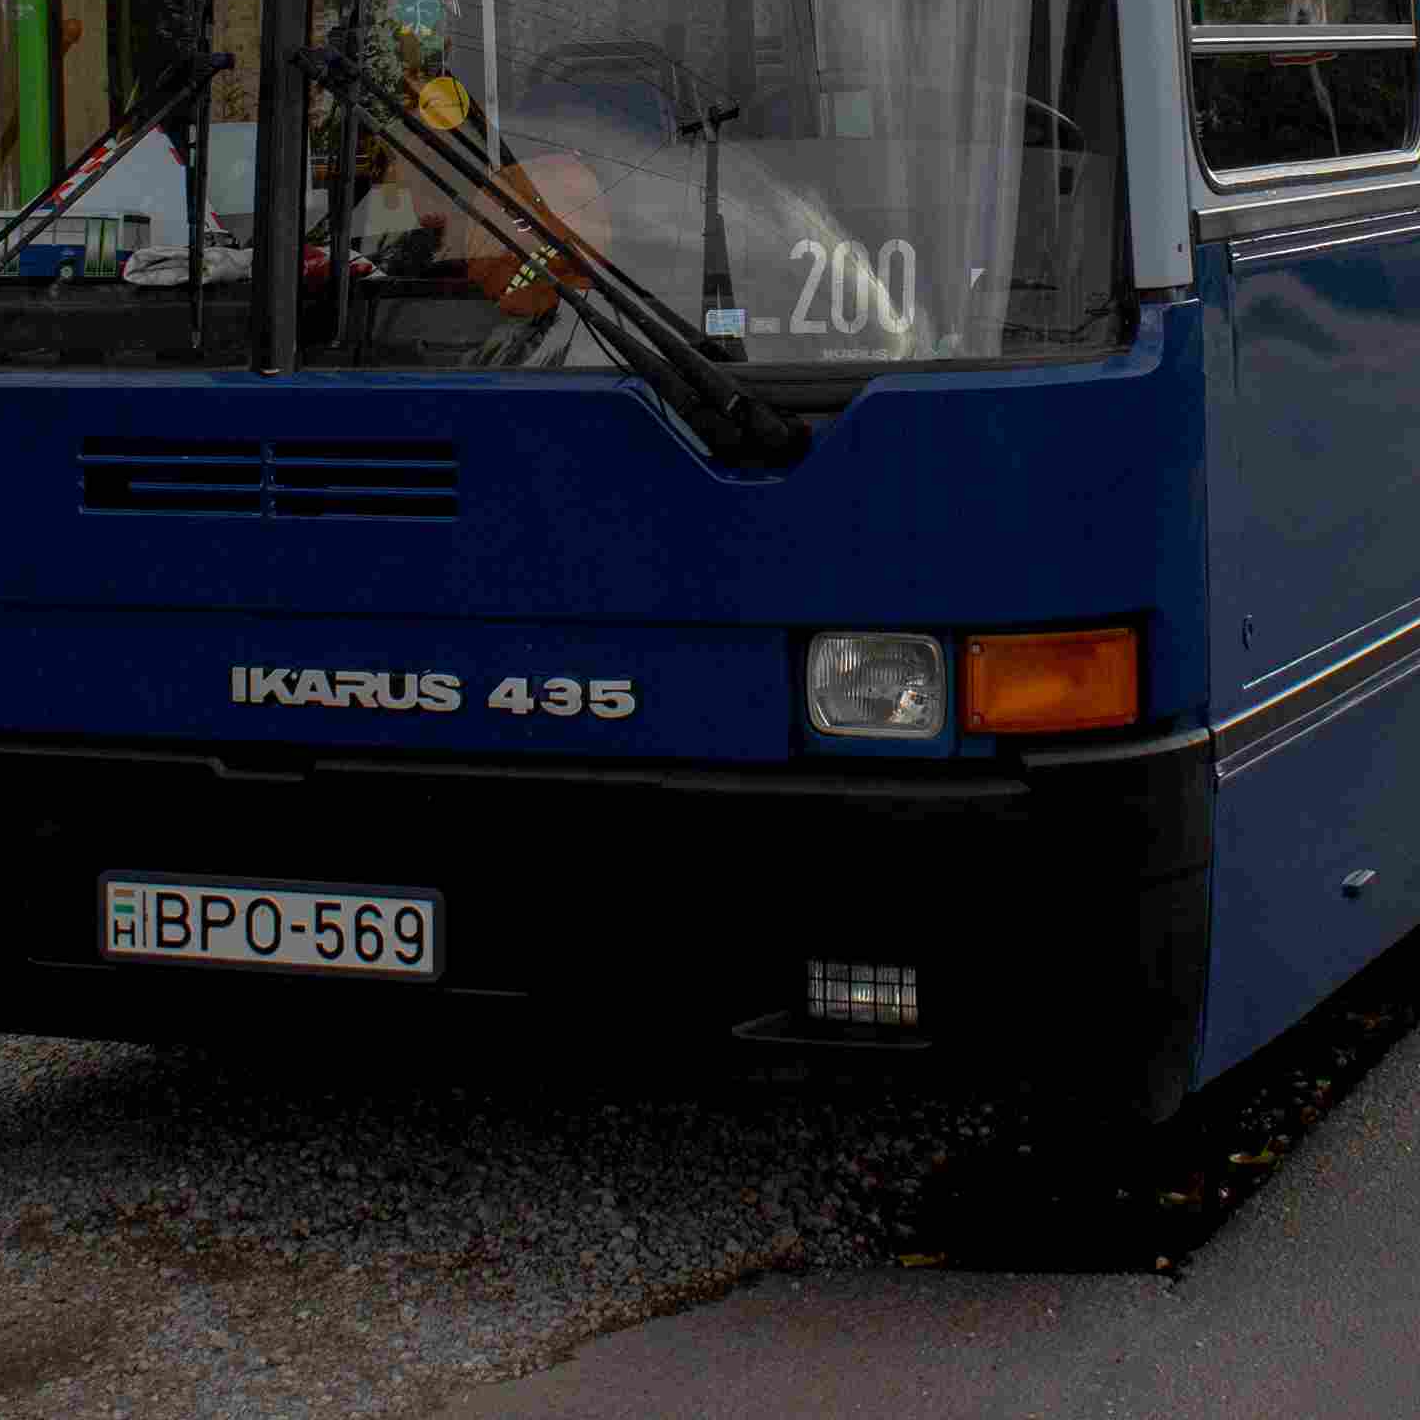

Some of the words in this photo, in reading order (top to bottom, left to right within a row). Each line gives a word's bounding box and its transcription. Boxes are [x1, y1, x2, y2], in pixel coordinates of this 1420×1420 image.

[788, 238, 916, 334] 200
[230, 666, 462, 713] IKARUS
[487, 677, 636, 718] 435
[112, 919, 136, 948] H
[155, 891, 426, 966] BPO-569
